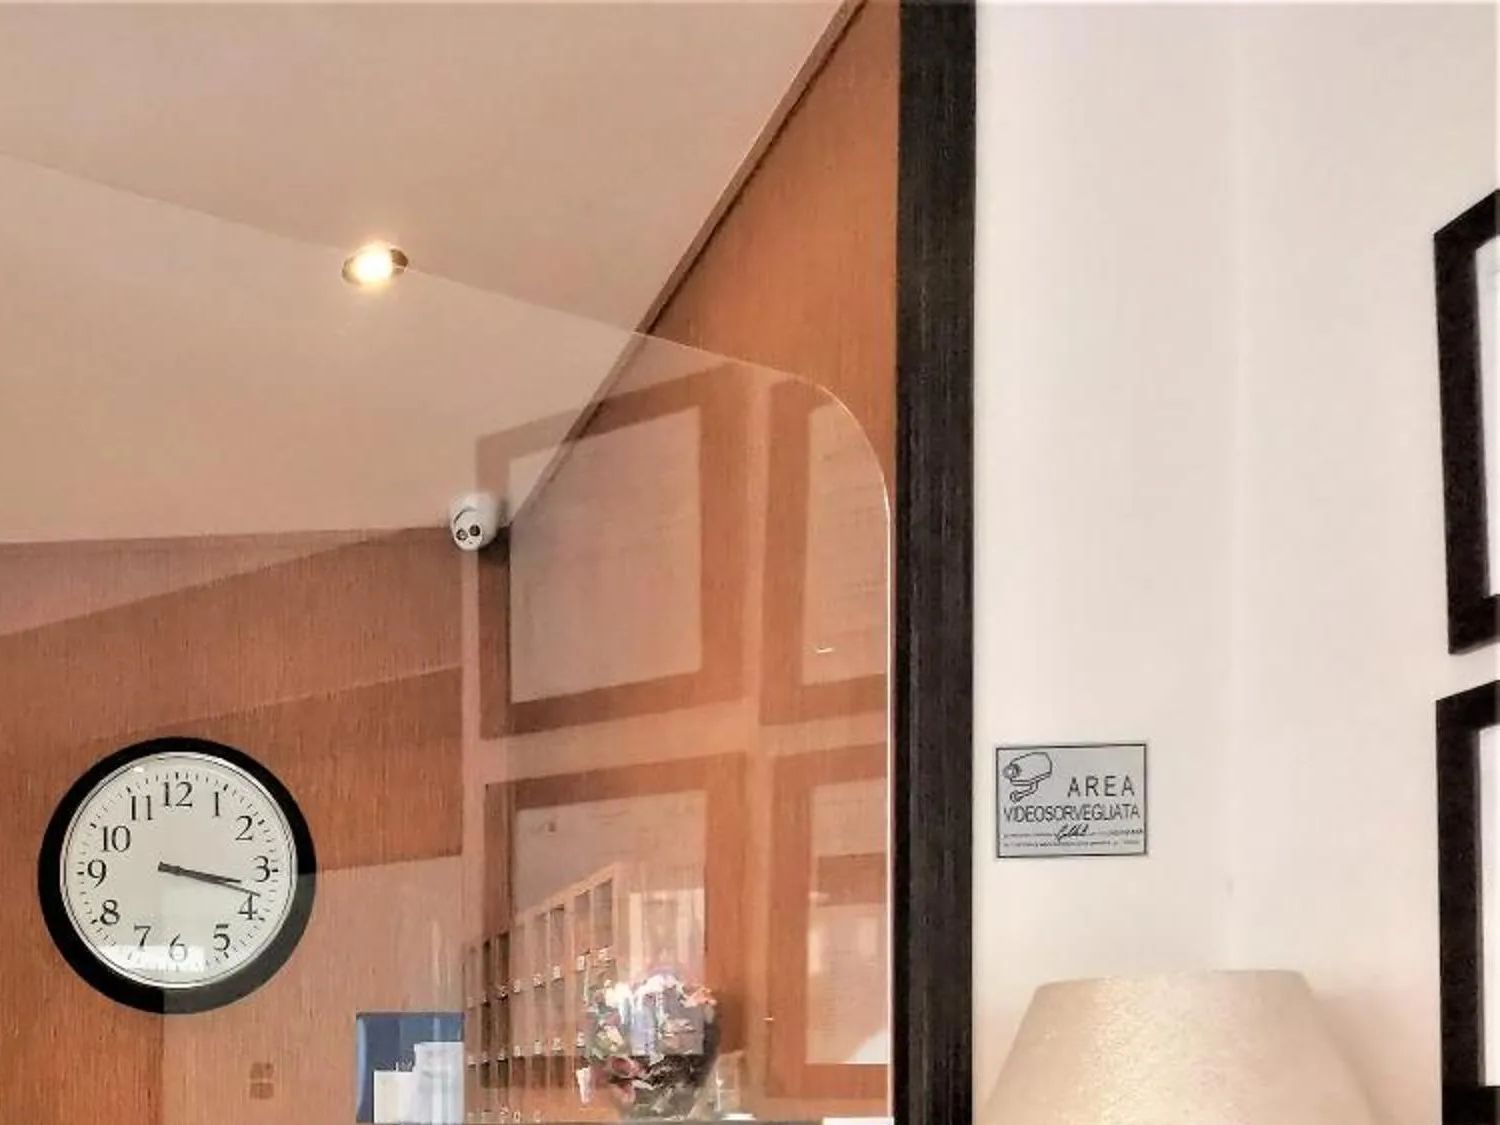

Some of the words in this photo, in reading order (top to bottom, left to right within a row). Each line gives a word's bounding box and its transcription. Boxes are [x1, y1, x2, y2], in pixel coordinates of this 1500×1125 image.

[162, 781, 193, 808] 12
[1067, 775, 1136, 798] AREA
[129, 794, 153, 821] 11
[212, 791, 222, 818] 1
[1003, 803, 1141, 823] VIDEOSORVEGLIATA
[100, 825, 131, 852] 10
[235, 815, 254, 841] 2
[87, 859, 107, 888] 9
[252, 855, 270, 883] 3
[100, 899, 121, 926] 8
[238, 894, 259, 920] 4
[133, 925, 152, 951] 7
[168, 933, 188, 962] 6
[213, 923, 231, 952] 5
